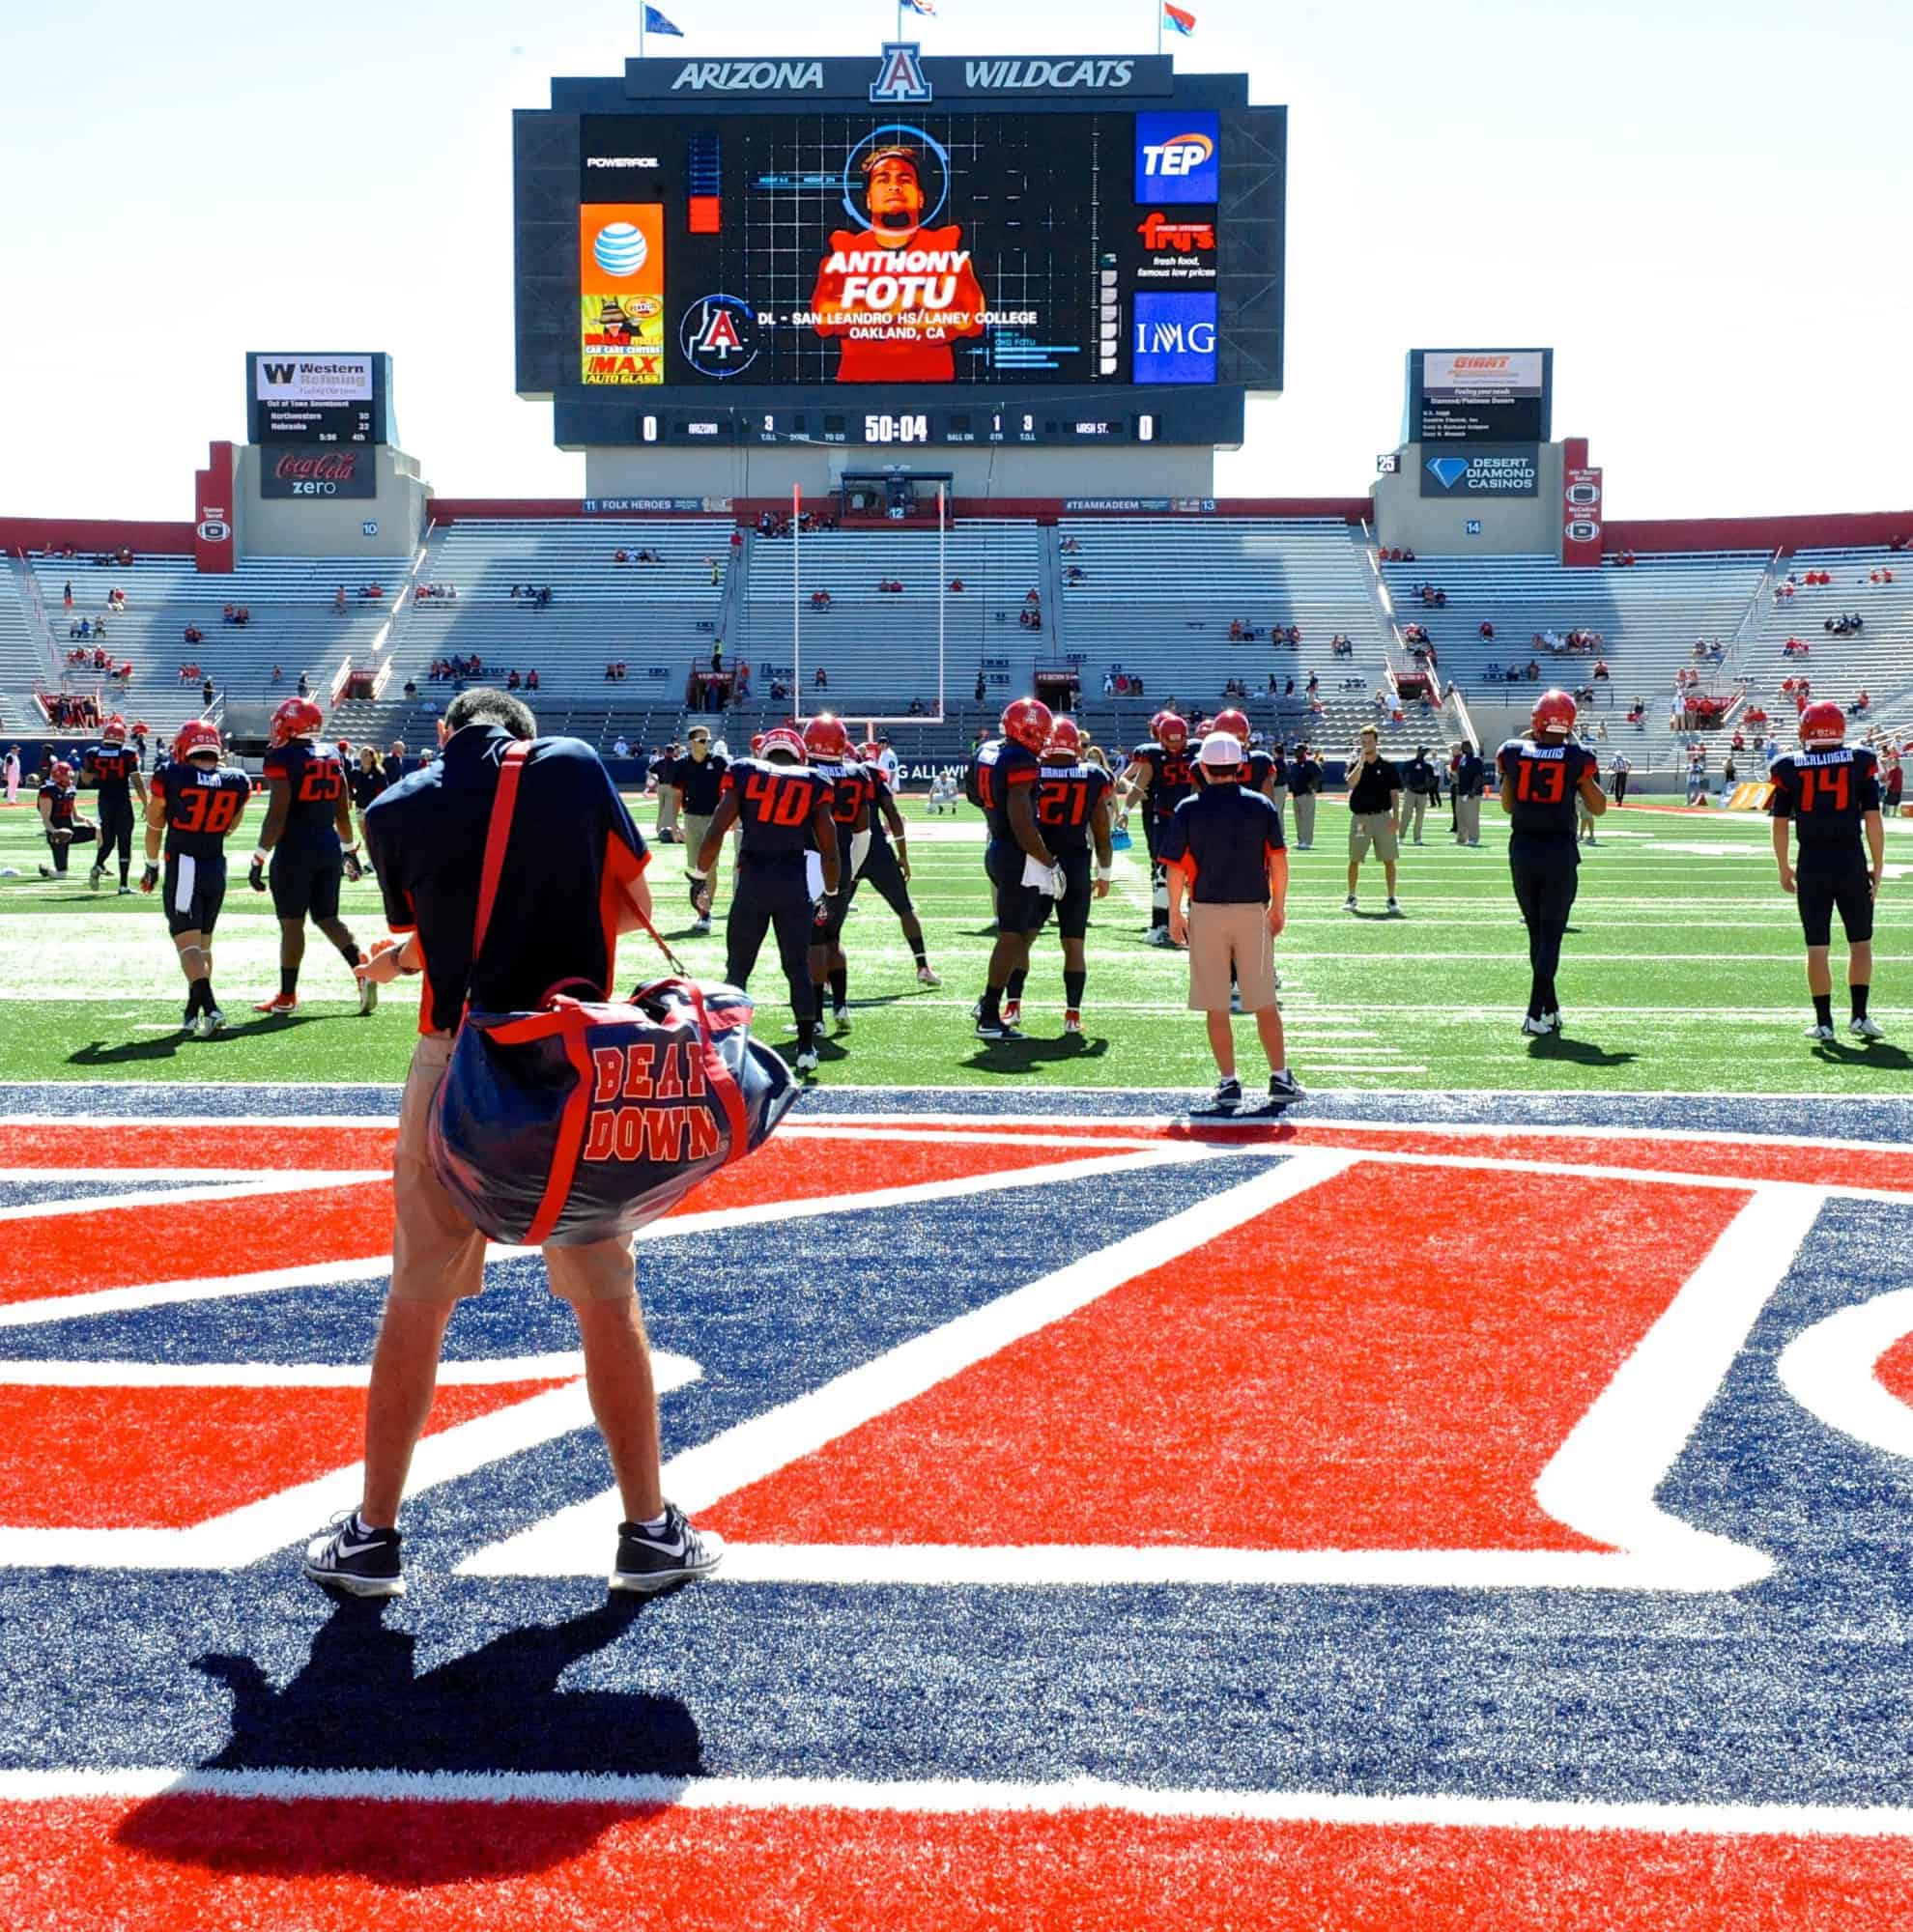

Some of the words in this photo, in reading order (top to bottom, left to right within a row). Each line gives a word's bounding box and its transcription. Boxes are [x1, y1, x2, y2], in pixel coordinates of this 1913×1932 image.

[671, 62, 824, 89] ARIZONA
[965, 60, 1134, 88] WILDCATS
[1143, 145, 1207, 176] TEP
[1137, 213, 1215, 251] fry's
[825, 251, 970, 273] ANTHONY
[1153, 256, 1176, 266] fresh
[1137, 268, 1171, 278] famous
[1171, 268, 1188, 278] low
[1188, 268, 1216, 279] prices
[841, 275, 957, 309] FOTU
[757, 312, 776, 325] DL
[792, 312, 822, 325] SAN
[826, 312, 893, 325] LEANDRO
[897, 311, 969, 326] HS/LANEY
[974, 312, 1038, 325] COLLEGE
[849, 327, 922, 340] OAKLAND,
[926, 327, 946, 339] CA
[1136, 324, 1216, 353] IMG
[300, 363, 364, 374] Western
[587, 374, 619, 384] AUTO
[620, 374, 659, 384] GLASS
[271, 422, 307, 431] Nebraska
[642, 415, 658, 441] 0
[764, 415, 774, 432] 3
[865, 415, 928, 442] 50:04
[992, 415, 1001, 432] 1
[1023, 415, 1033, 432] 3
[1138, 415, 1154, 441] 0
[1378, 457, 1395, 472] 25
[1473, 459, 1529, 468] DESERT
[1467, 468, 1535, 478] DIAMOND
[293, 481, 336, 495] zero
[1468, 478, 1533, 488] CASINOS
[585, 500, 596, 510] 11
[602, 500, 629, 510] FOLK
[631, 500, 671, 510] HEROES
[889, 507, 904, 518] 12
[1067, 500, 1139, 510] #TEAMKADEEM
[1202, 500, 1214, 511] 13
[363, 525, 378, 534] 10
[1467, 522, 1480, 532] 14
[299, 758, 341, 801] 25
[911, 764, 939, 779] ALL
[1516, 760, 1567, 803] 13
[1798, 766, 1849, 811] 14
[745, 772, 814, 827] 40
[1040, 782, 1089, 825] 21
[172, 788, 240, 833] 38
[584, 1105, 721, 1161] DOWN
